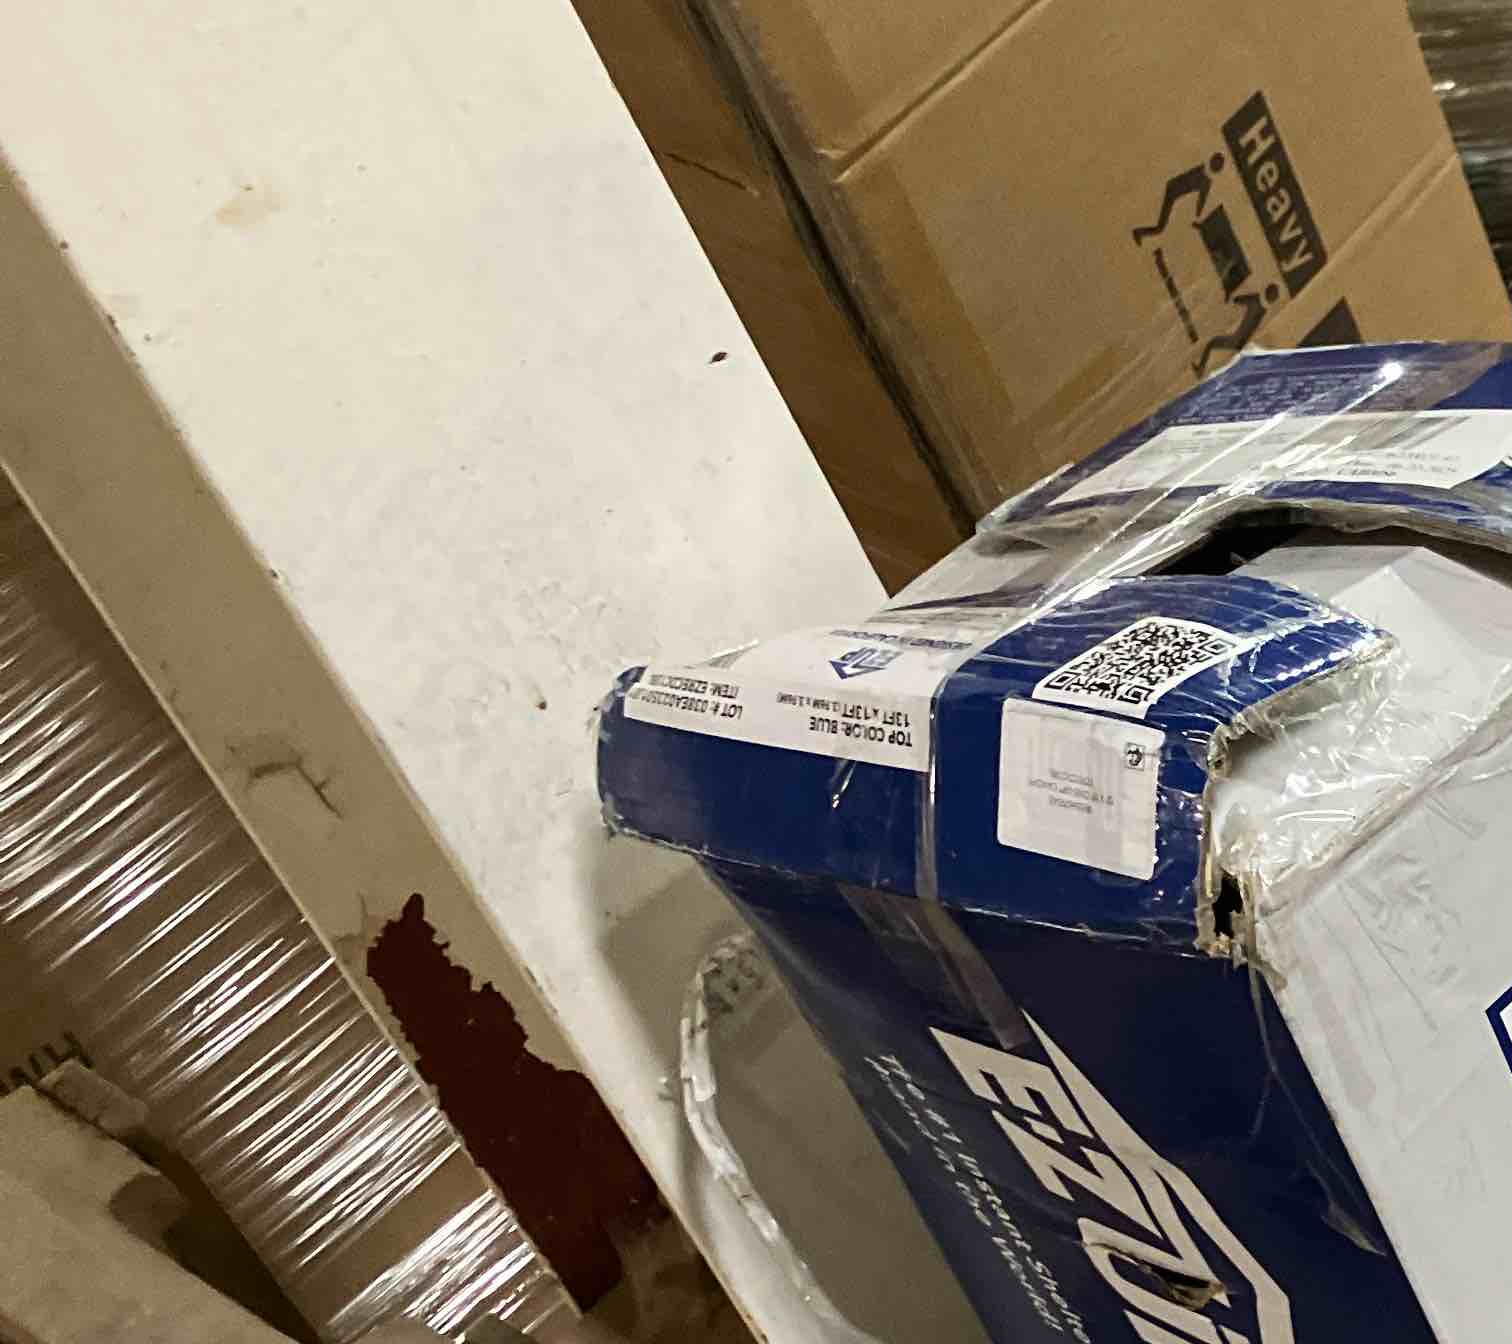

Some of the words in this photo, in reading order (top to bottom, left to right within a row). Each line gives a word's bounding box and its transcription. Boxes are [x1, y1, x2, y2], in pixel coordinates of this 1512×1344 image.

[1240, 115, 1314, 274] Heavy
[719, 702, 743, 720] LOT
[842, 703, 872, 721] 13FT
[882, 710, 911, 727] 13FT
[809, 716, 839, 736] BLUE
[839, 721, 886, 743] COLOR:
[888, 728, 914, 747] TOP
